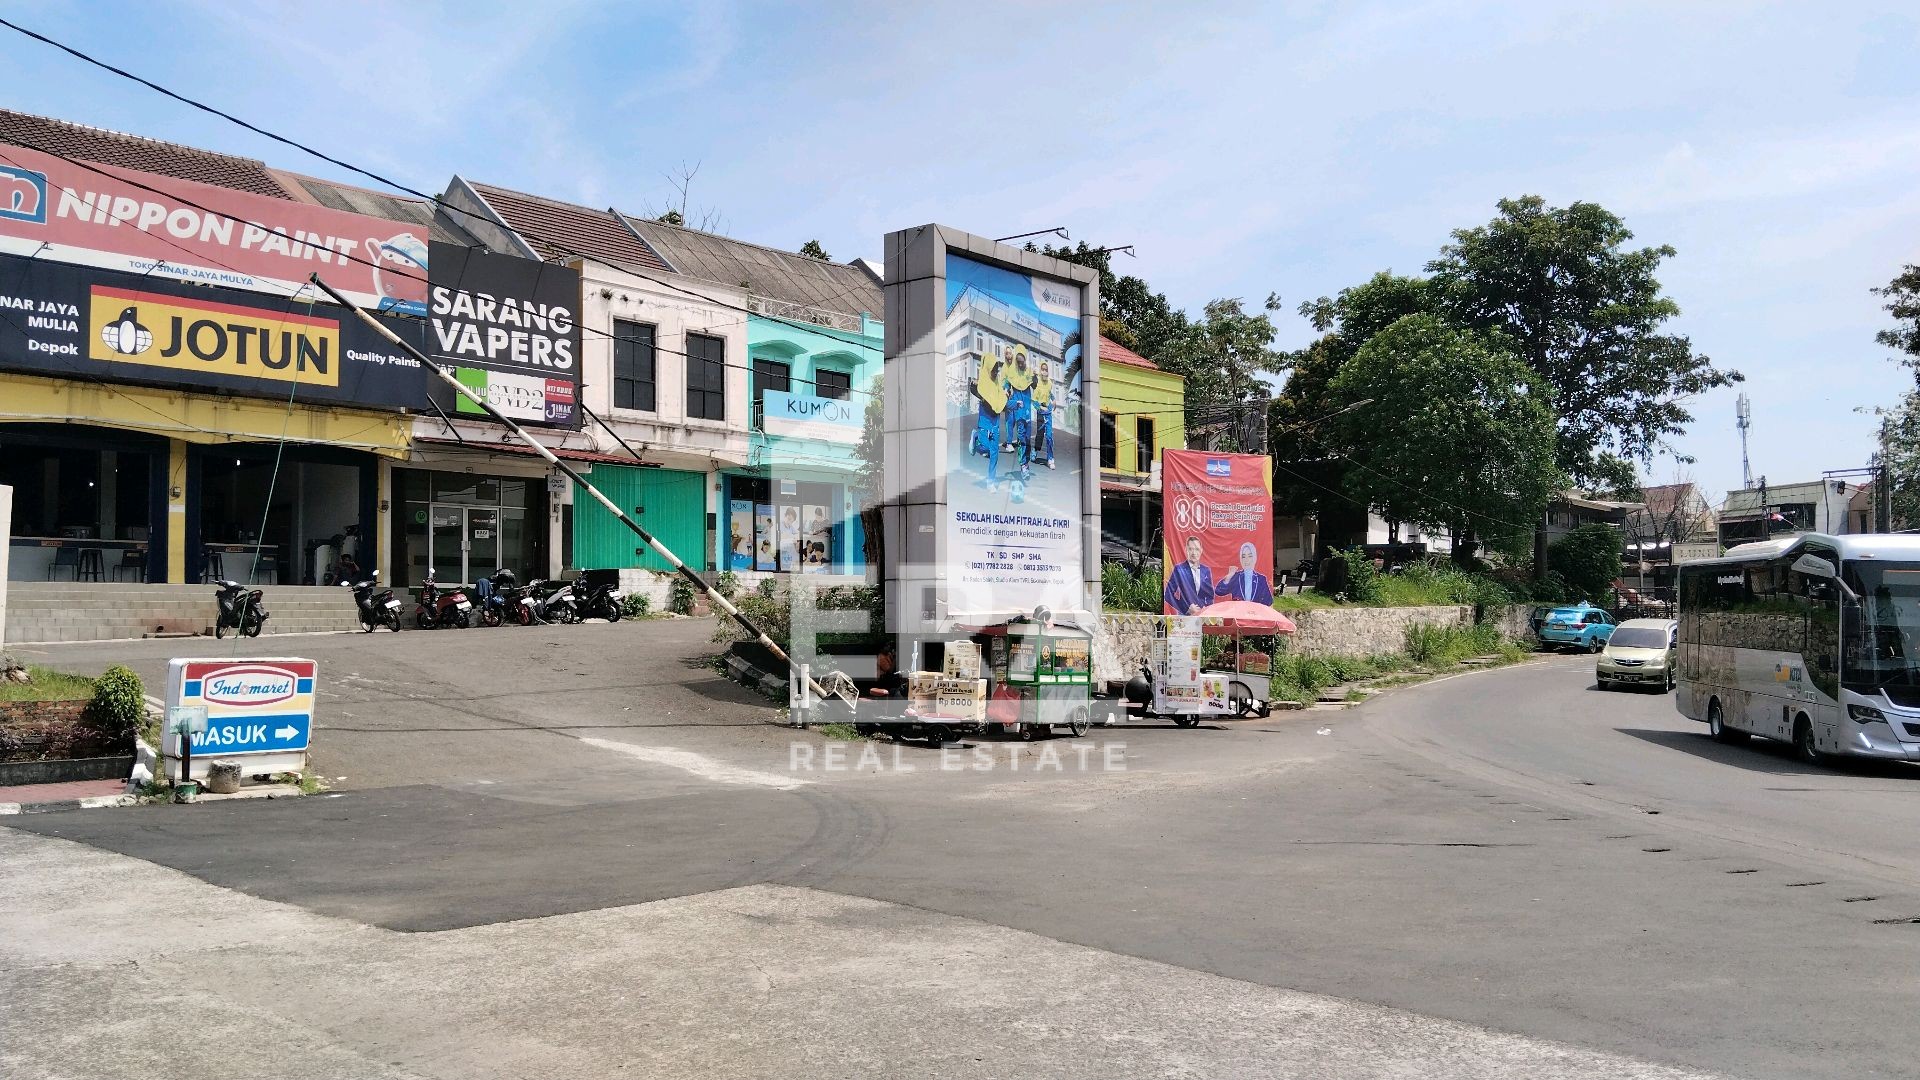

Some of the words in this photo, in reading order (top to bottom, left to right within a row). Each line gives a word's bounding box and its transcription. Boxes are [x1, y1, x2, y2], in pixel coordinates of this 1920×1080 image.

[56, 187, 235, 246] NIPPON
[240, 219, 358, 267] PAINT
[129, 260, 154, 271] TOKO
[156, 263, 189, 276] SINAR
[191, 269, 218, 281] JAYA
[219, 271, 254, 286] MULYA
[38, 301, 80, 317] JAYA
[431, 286, 573, 335] SARANG
[28, 315, 79, 333] MULIA
[28, 339, 79, 356] Depok
[160, 316, 328, 375] JOTUN
[431, 318, 573, 370] VAPERS
[346, 349, 386, 366] Quality
[388, 355, 421, 368] Paints
[787, 398, 851, 422] KUMON
[956, 511, 991, 524] SEKOLAH
[992, 514, 1015, 525] ISLAM
[1016, 516, 1042, 527] FITRAH
[1043, 518, 1051, 528] AL
[1052, 519, 1070, 529] FIKRI
[1173, 493, 1210, 534] 80
[993, 528, 1018, 539] dengan
[1019, 528, 1048, 540] kekuatan
[1049, 531, 1066, 540] fitrah
[986, 551, 995, 559] TK
[999, 552, 1008, 560] SD
[1011, 552, 1025, 560] SMP
[1028, 553, 1042, 561] SMA
[209, 679, 290, 696] Indomaret
[938, 697, 949, 707] Rp
